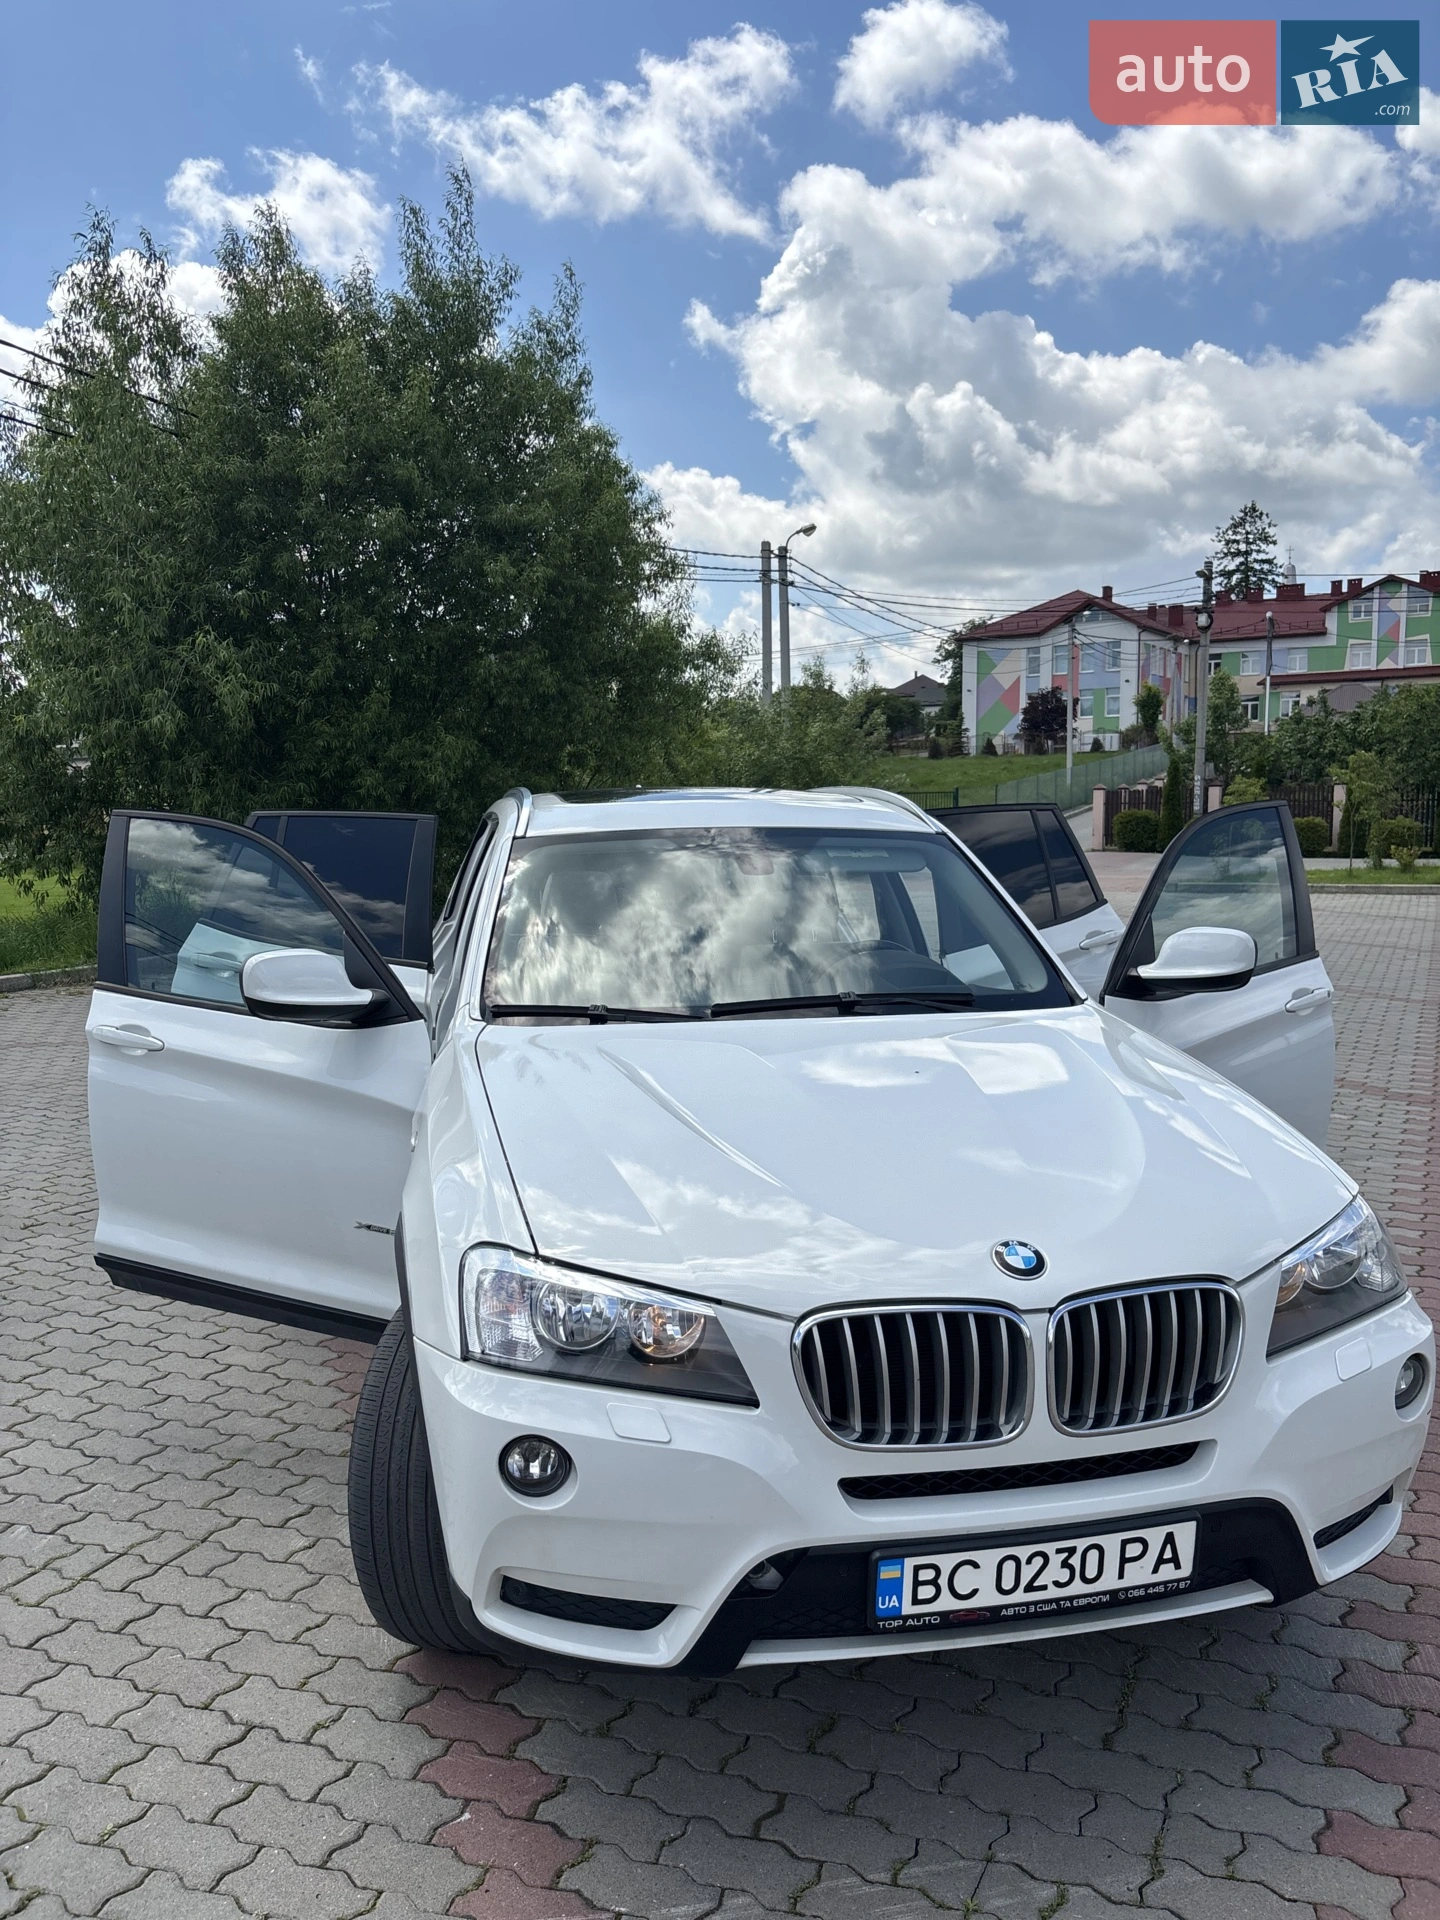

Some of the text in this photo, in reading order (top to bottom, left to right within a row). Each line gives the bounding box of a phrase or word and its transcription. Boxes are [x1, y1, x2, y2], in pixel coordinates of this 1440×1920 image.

[995, 1240, 1037, 1253] BMW
[911, 1531, 1182, 1606] BC 0230 PA
[1127, 1580, 1191, 1597] 066 445 77 87
[878, 1595, 899, 1609] UA
[1000, 1605, 1027, 1617] АВТО
[1036, 1602, 1058, 1613] США
[1059, 1600, 1071, 1609] ТА
[1072, 1594, 1110, 1607] ЄВРОПИ
[877, 1615, 940, 1629] TOP AUTO
